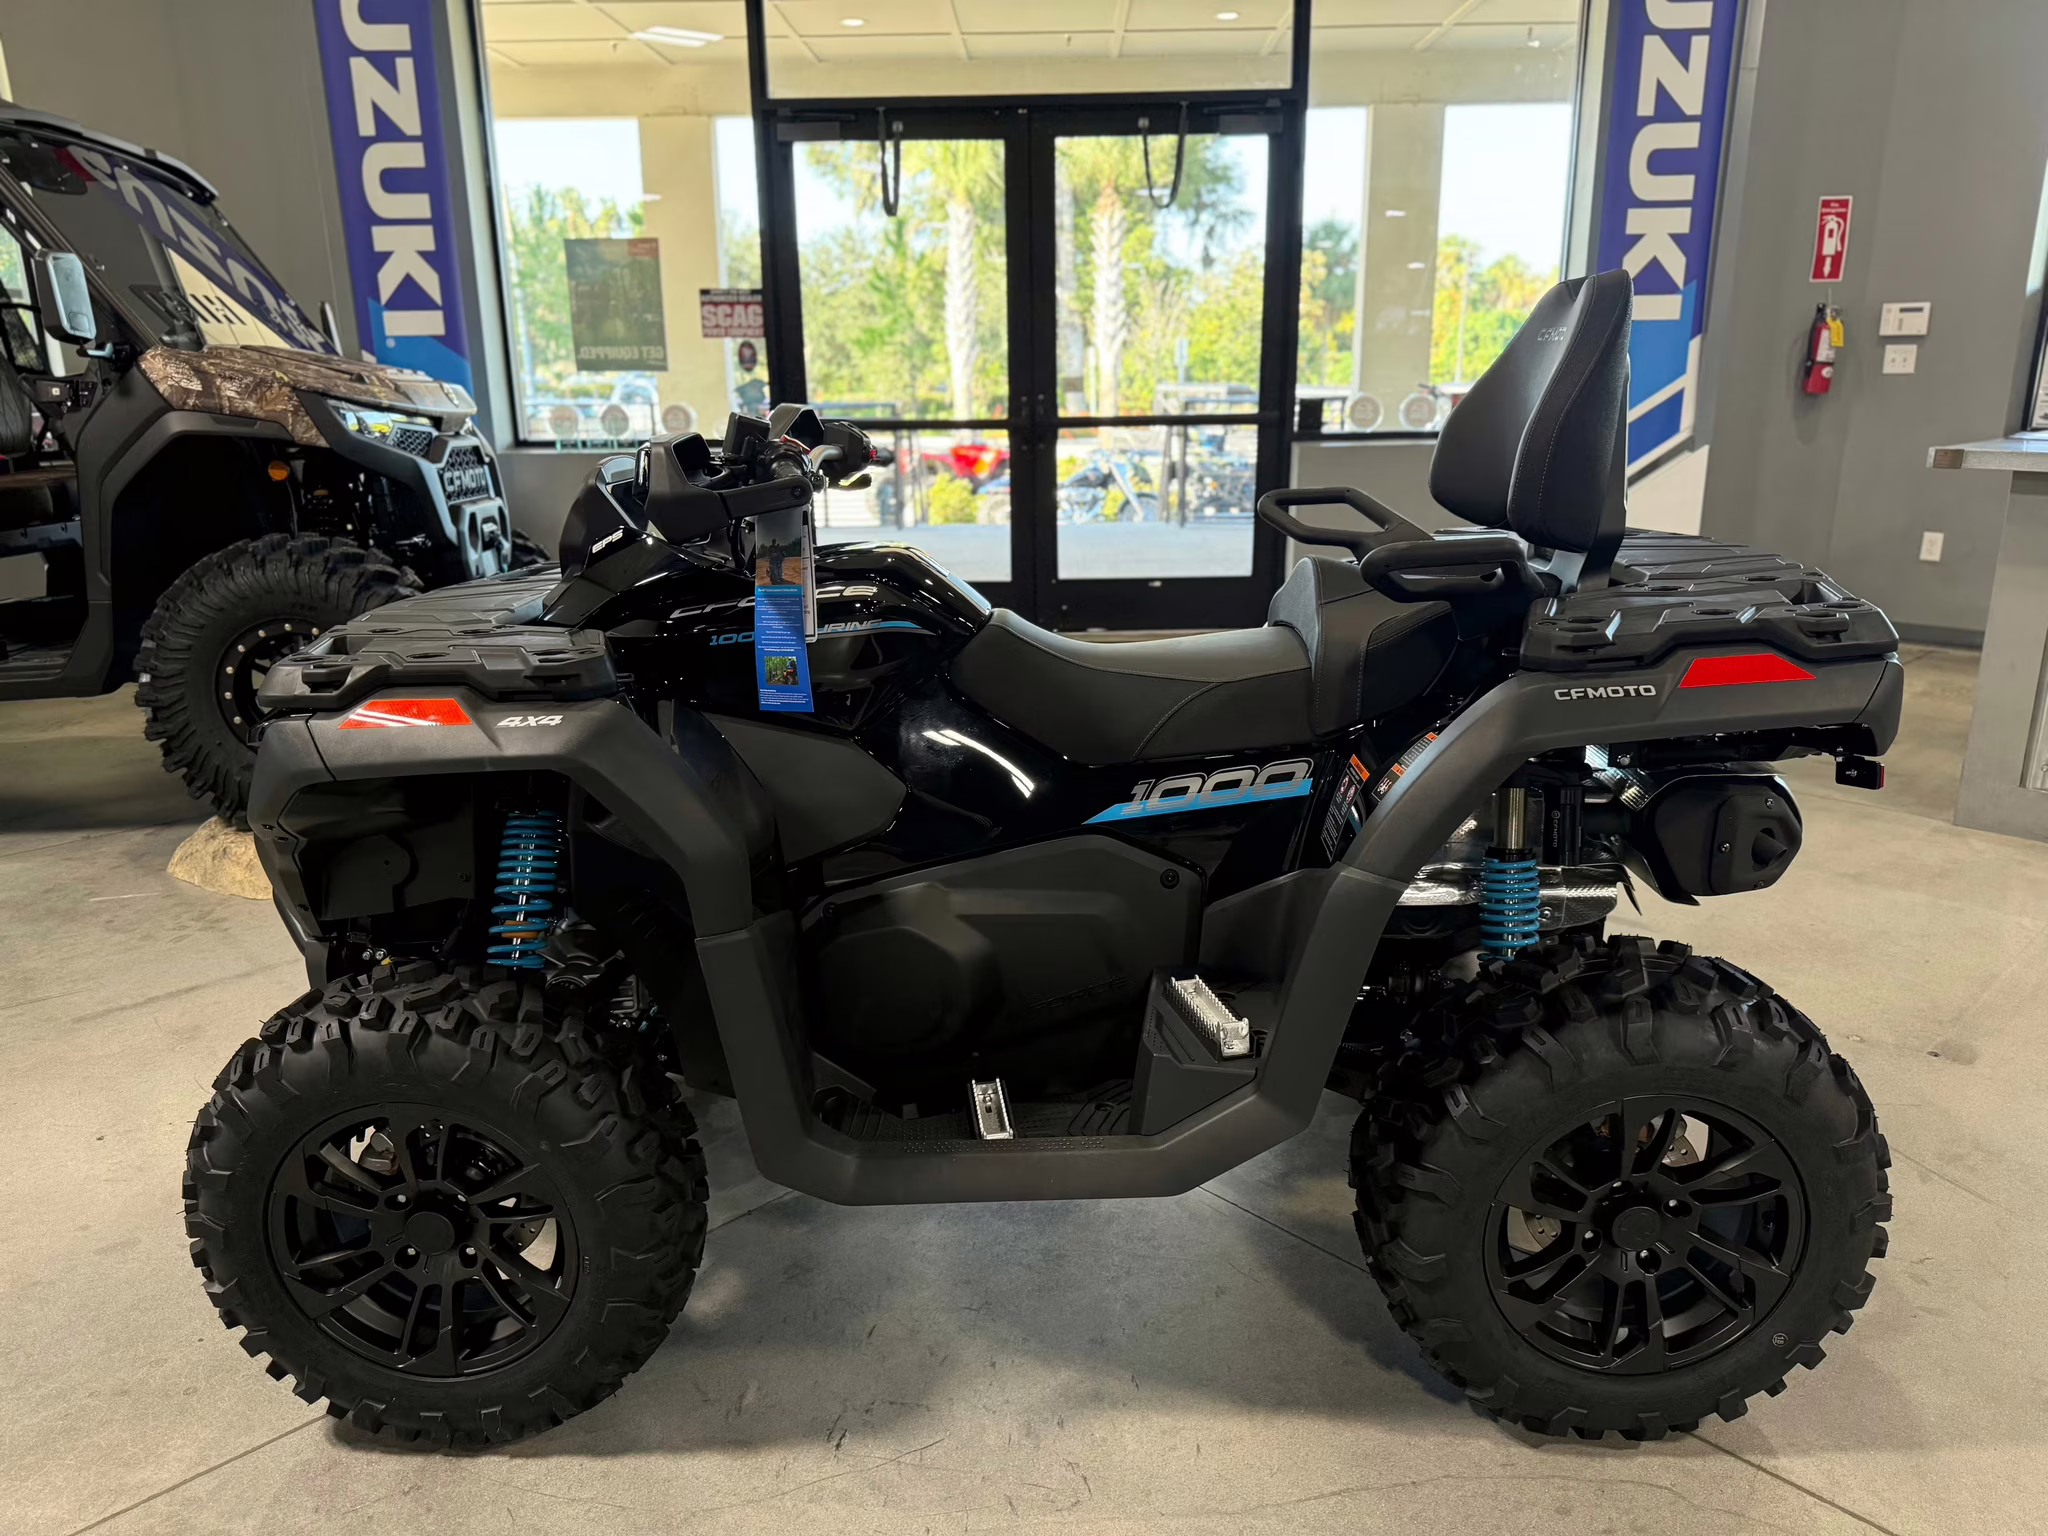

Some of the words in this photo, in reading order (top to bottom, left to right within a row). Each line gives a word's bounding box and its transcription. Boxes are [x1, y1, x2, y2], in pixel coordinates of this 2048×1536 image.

[703, 304, 764, 327] SCAG
[443, 467, 486, 492] CFMOTO
[592, 529, 624, 554] EPS
[1554, 684, 1656, 700] CFMOTO
[496, 715, 564, 728] 4X4
[1121, 757, 1314, 815] 1000
